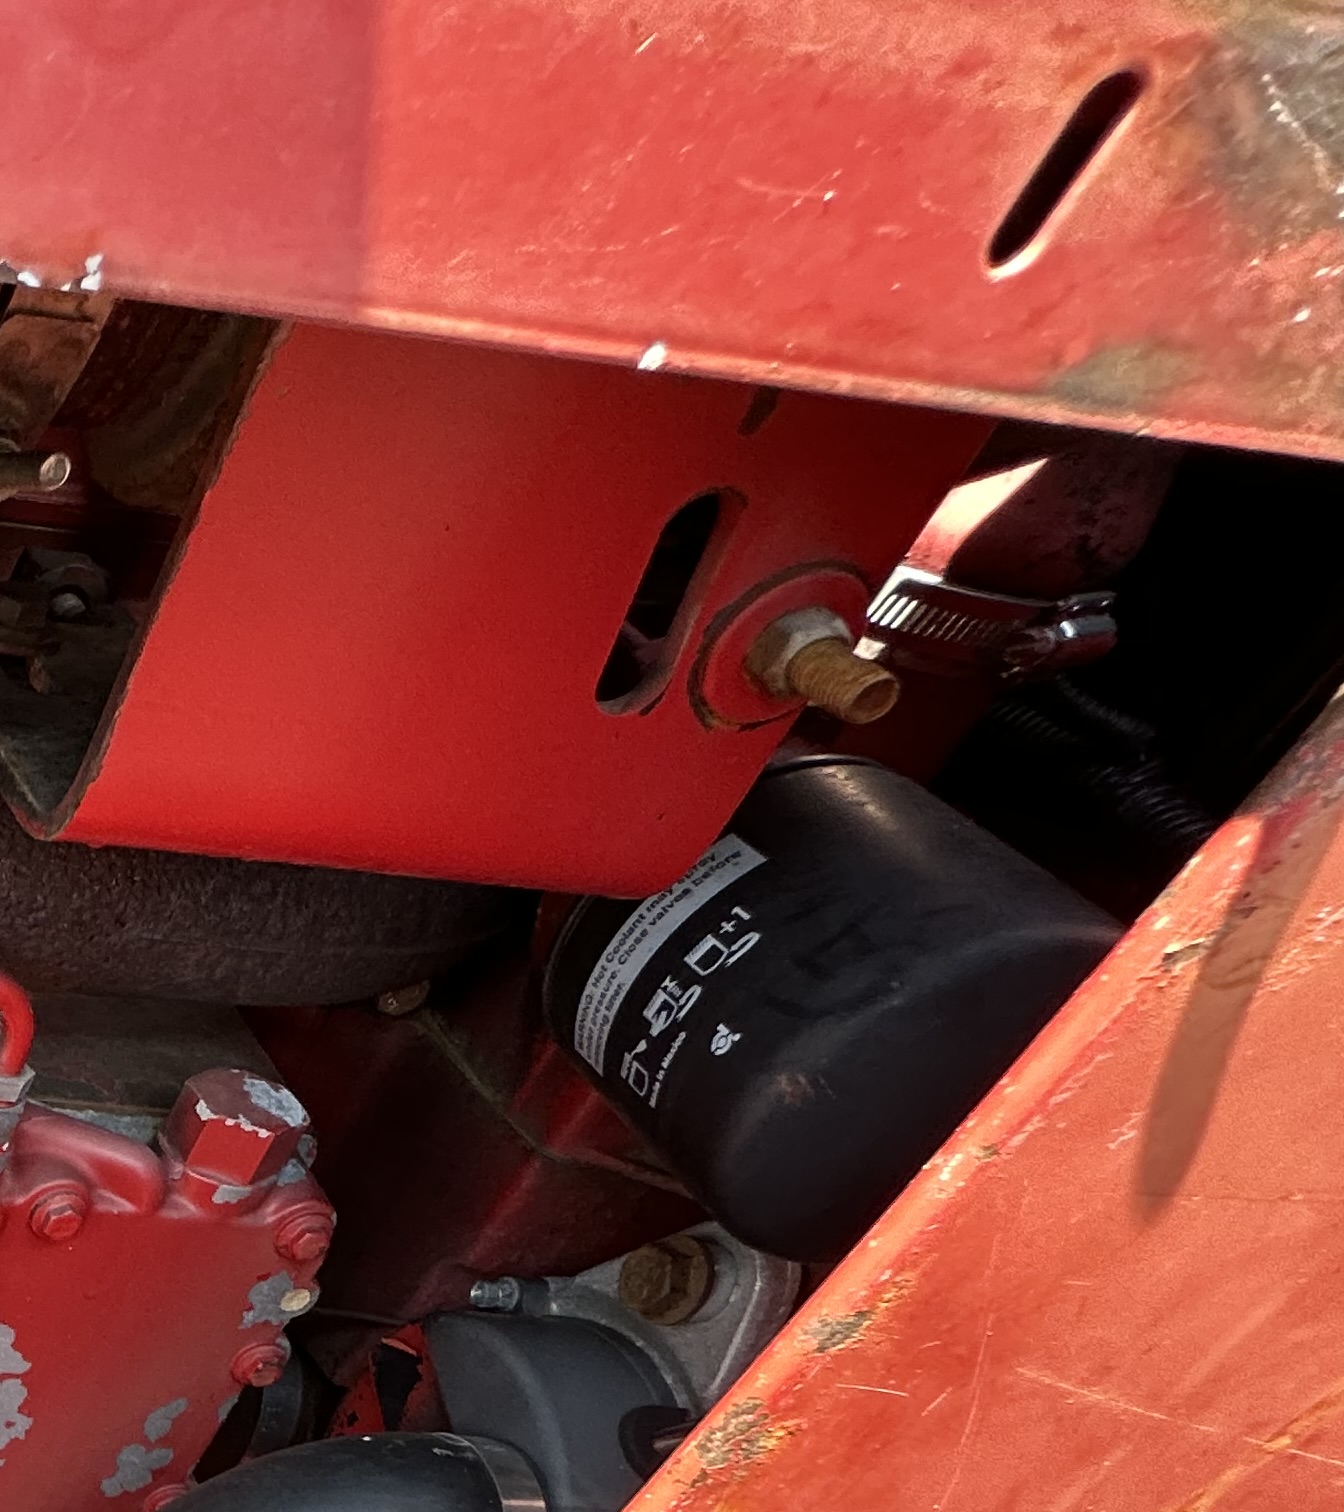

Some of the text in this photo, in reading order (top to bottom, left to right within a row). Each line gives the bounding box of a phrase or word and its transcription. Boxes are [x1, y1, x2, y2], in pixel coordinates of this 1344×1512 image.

[591, 965, 608, 988] Hot
[605, 913, 646, 963] Coolant
[645, 887, 673, 914] may
[616, 928, 649, 966] Close
[648, 886, 692, 927] valves
[690, 850, 741, 887] before
